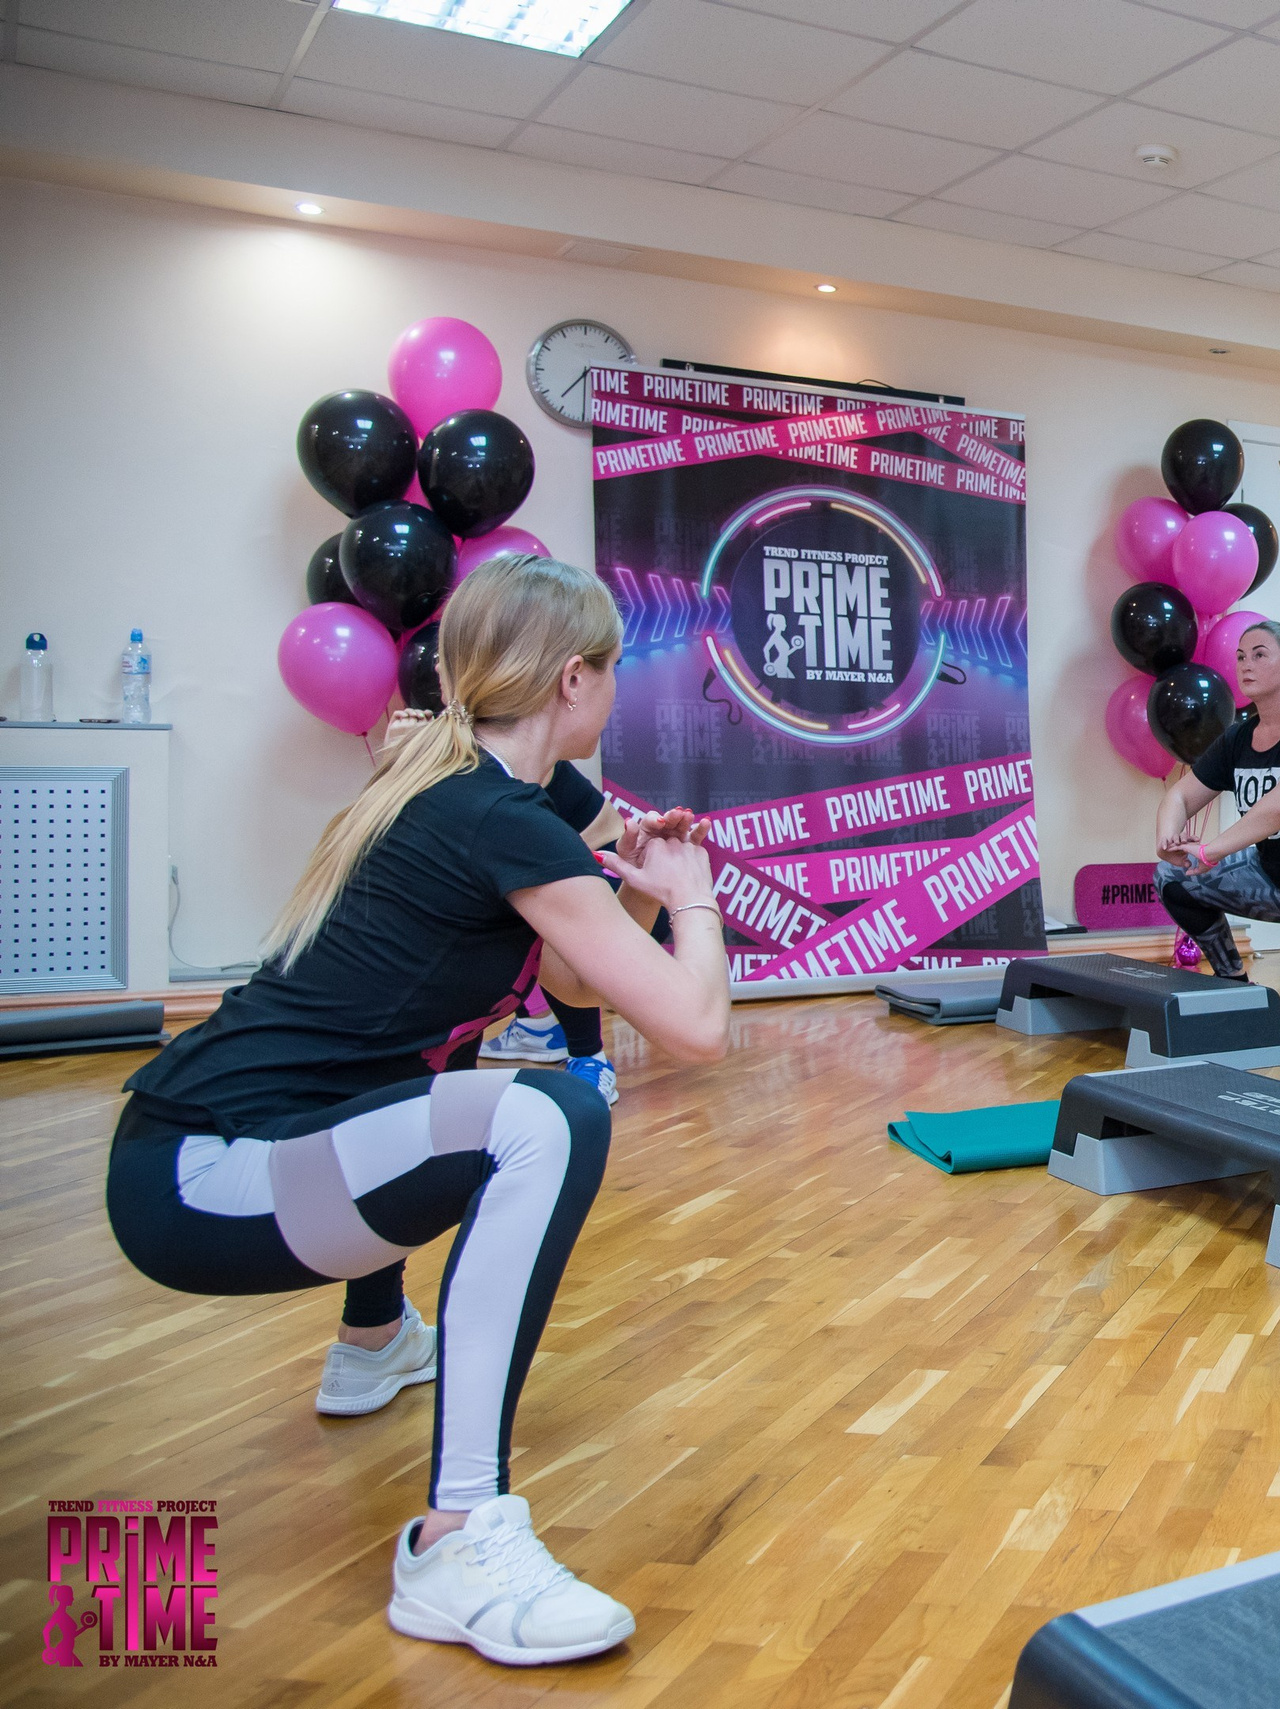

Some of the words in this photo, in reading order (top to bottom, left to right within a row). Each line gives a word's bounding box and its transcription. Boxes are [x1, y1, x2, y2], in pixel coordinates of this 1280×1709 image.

[643, 374, 729, 406] PRIMETIME
[596, 439, 686, 474] PRIMETIME
[694, 426, 779, 458] PRIMETIME
[787, 413, 868, 445] PRIMETIME
[957, 434, 1025, 487] PRIMETIME
[870, 451, 945, 485] PRIMETIME
[763, 546, 799, 559] TREND
[801, 549, 843, 562] FITNESS
[844, 553, 889, 566] PROJECT
[798, 614, 893, 670] TIME
[806, 669, 823, 680] BY
[825, 670, 866, 682] MAYER
[867, 672, 894, 683] N&A
[825, 776, 951, 833] PRIMETIME
